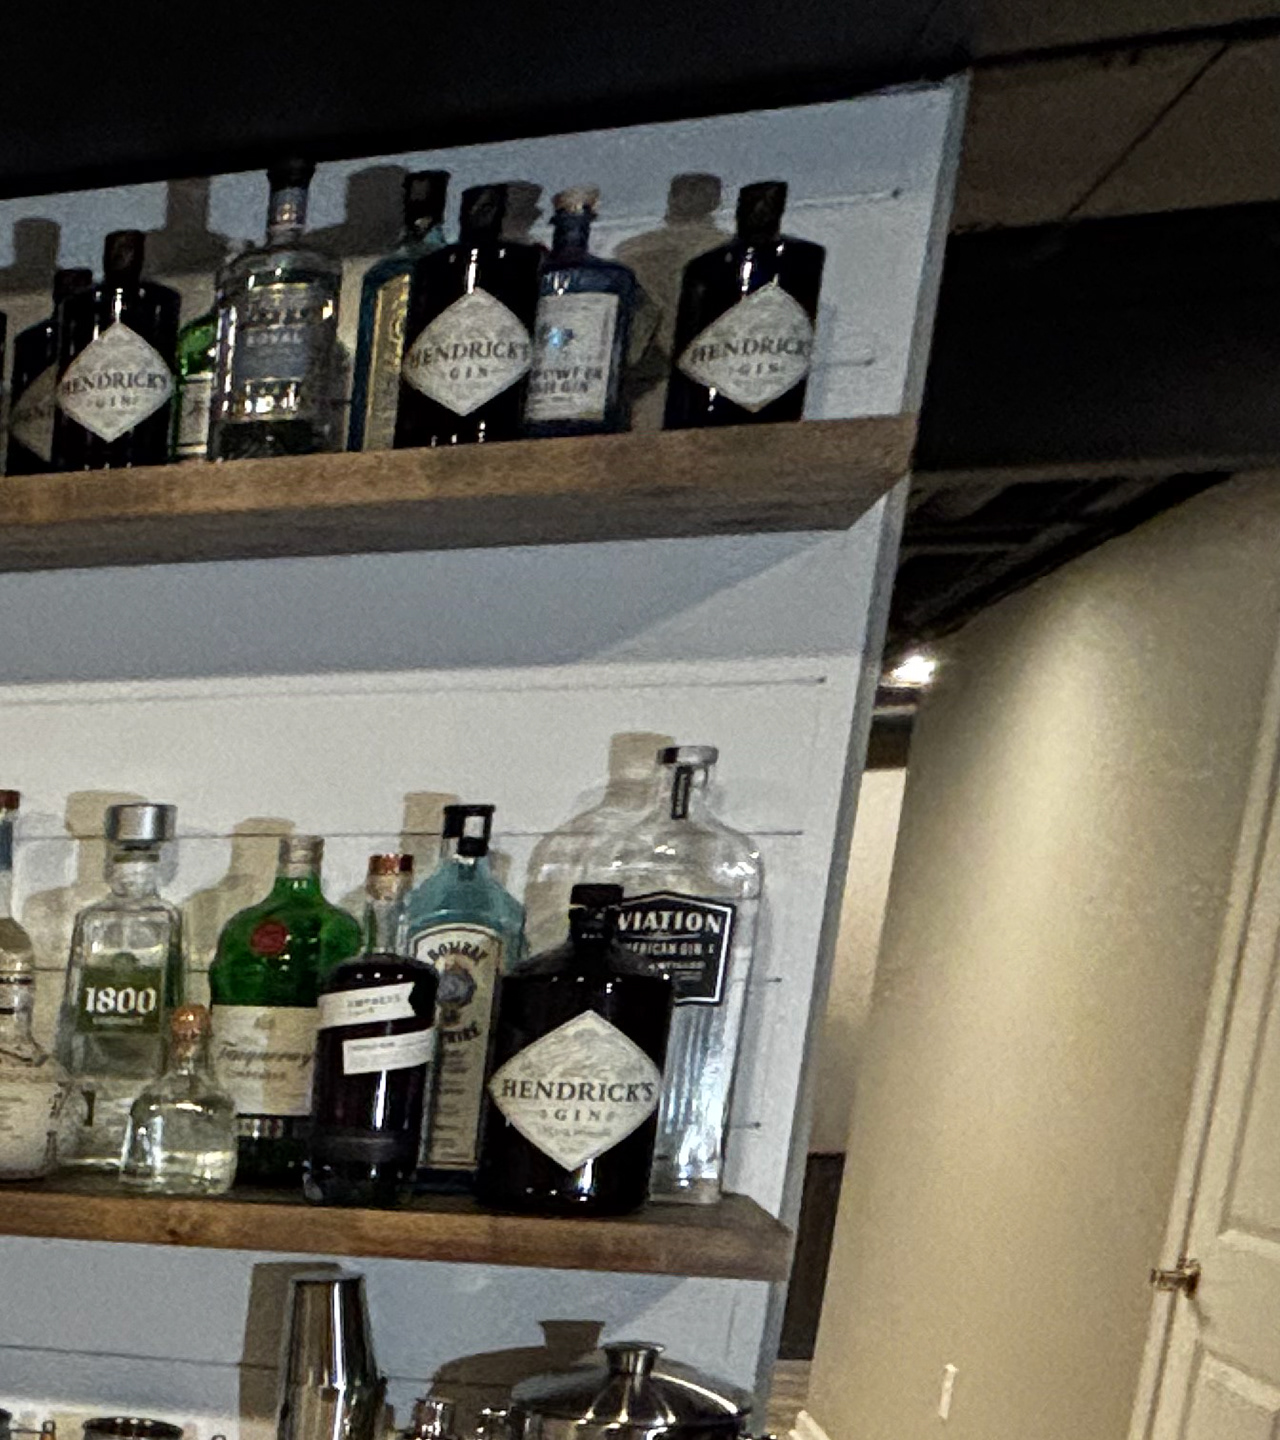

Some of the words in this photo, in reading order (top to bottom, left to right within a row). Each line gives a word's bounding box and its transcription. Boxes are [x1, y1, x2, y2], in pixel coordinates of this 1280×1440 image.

[616, 910, 723, 935] VIATION
[84, 986, 158, 1015] 1800
[500, 1078, 655, 1103] HENDRICK'S
[554, 1108, 601, 1122] GIN
